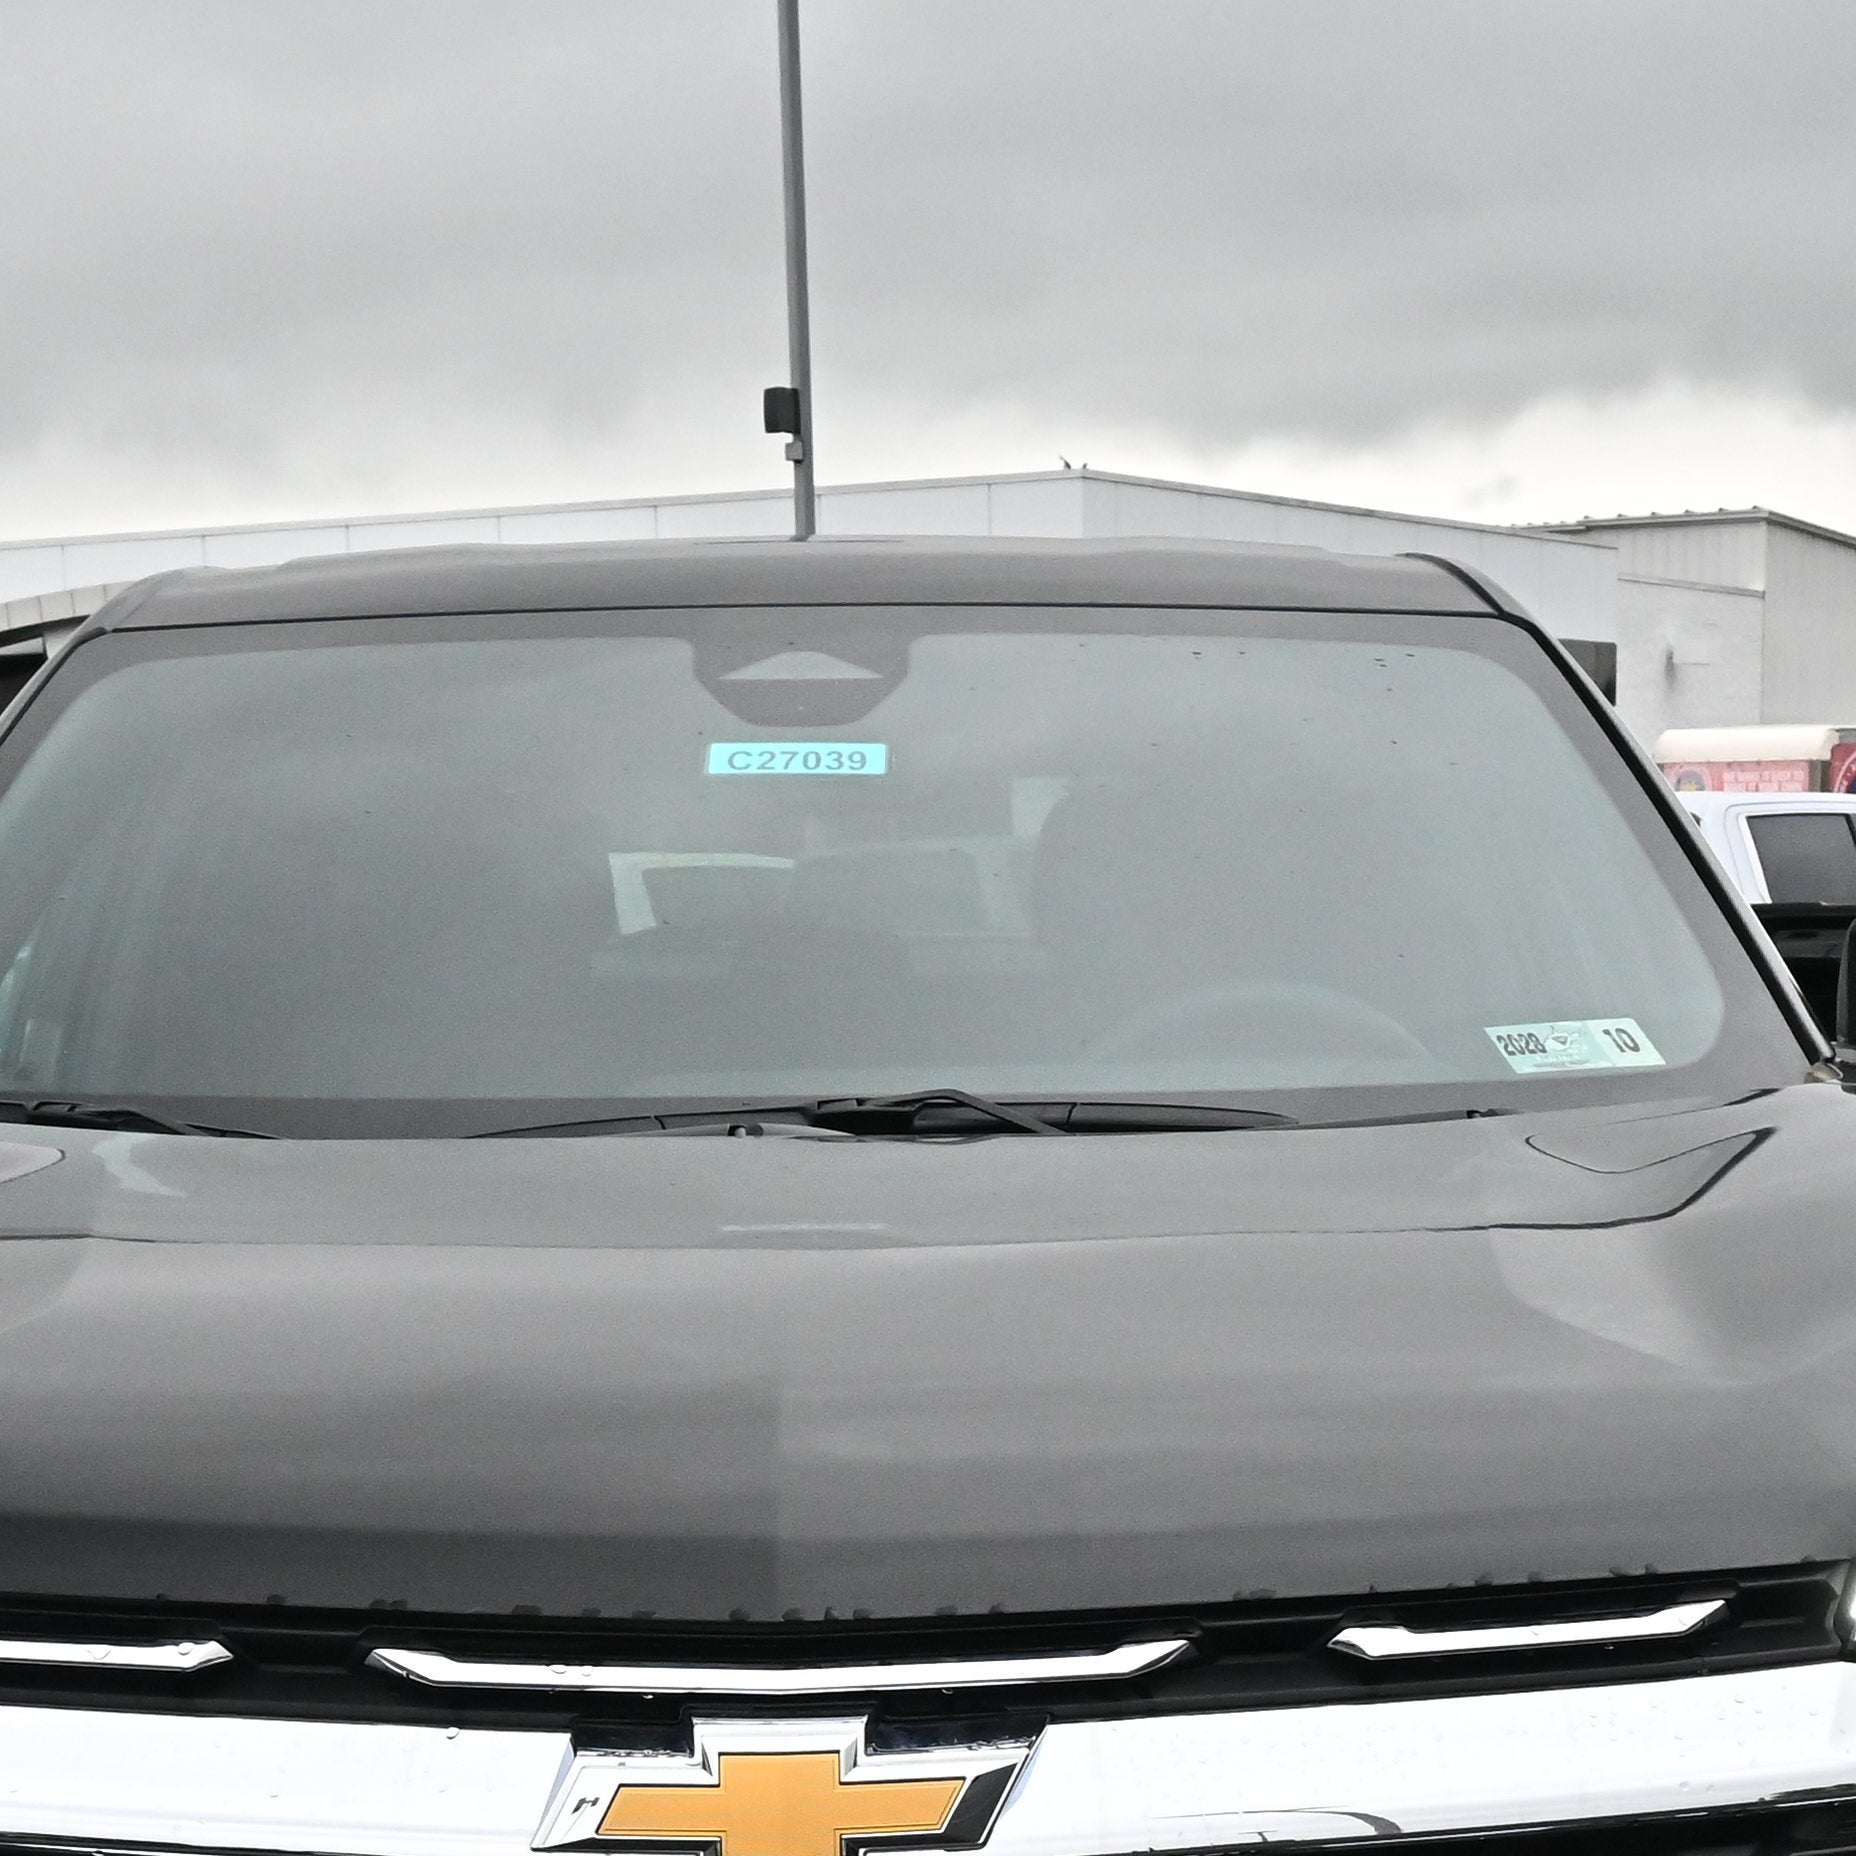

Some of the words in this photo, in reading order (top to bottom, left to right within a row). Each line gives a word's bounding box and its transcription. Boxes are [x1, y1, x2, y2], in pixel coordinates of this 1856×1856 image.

[727, 751, 867, 771] C27039
[1496, 1032, 1548, 1057] 2028
[1602, 1027, 1641, 1053] 10
